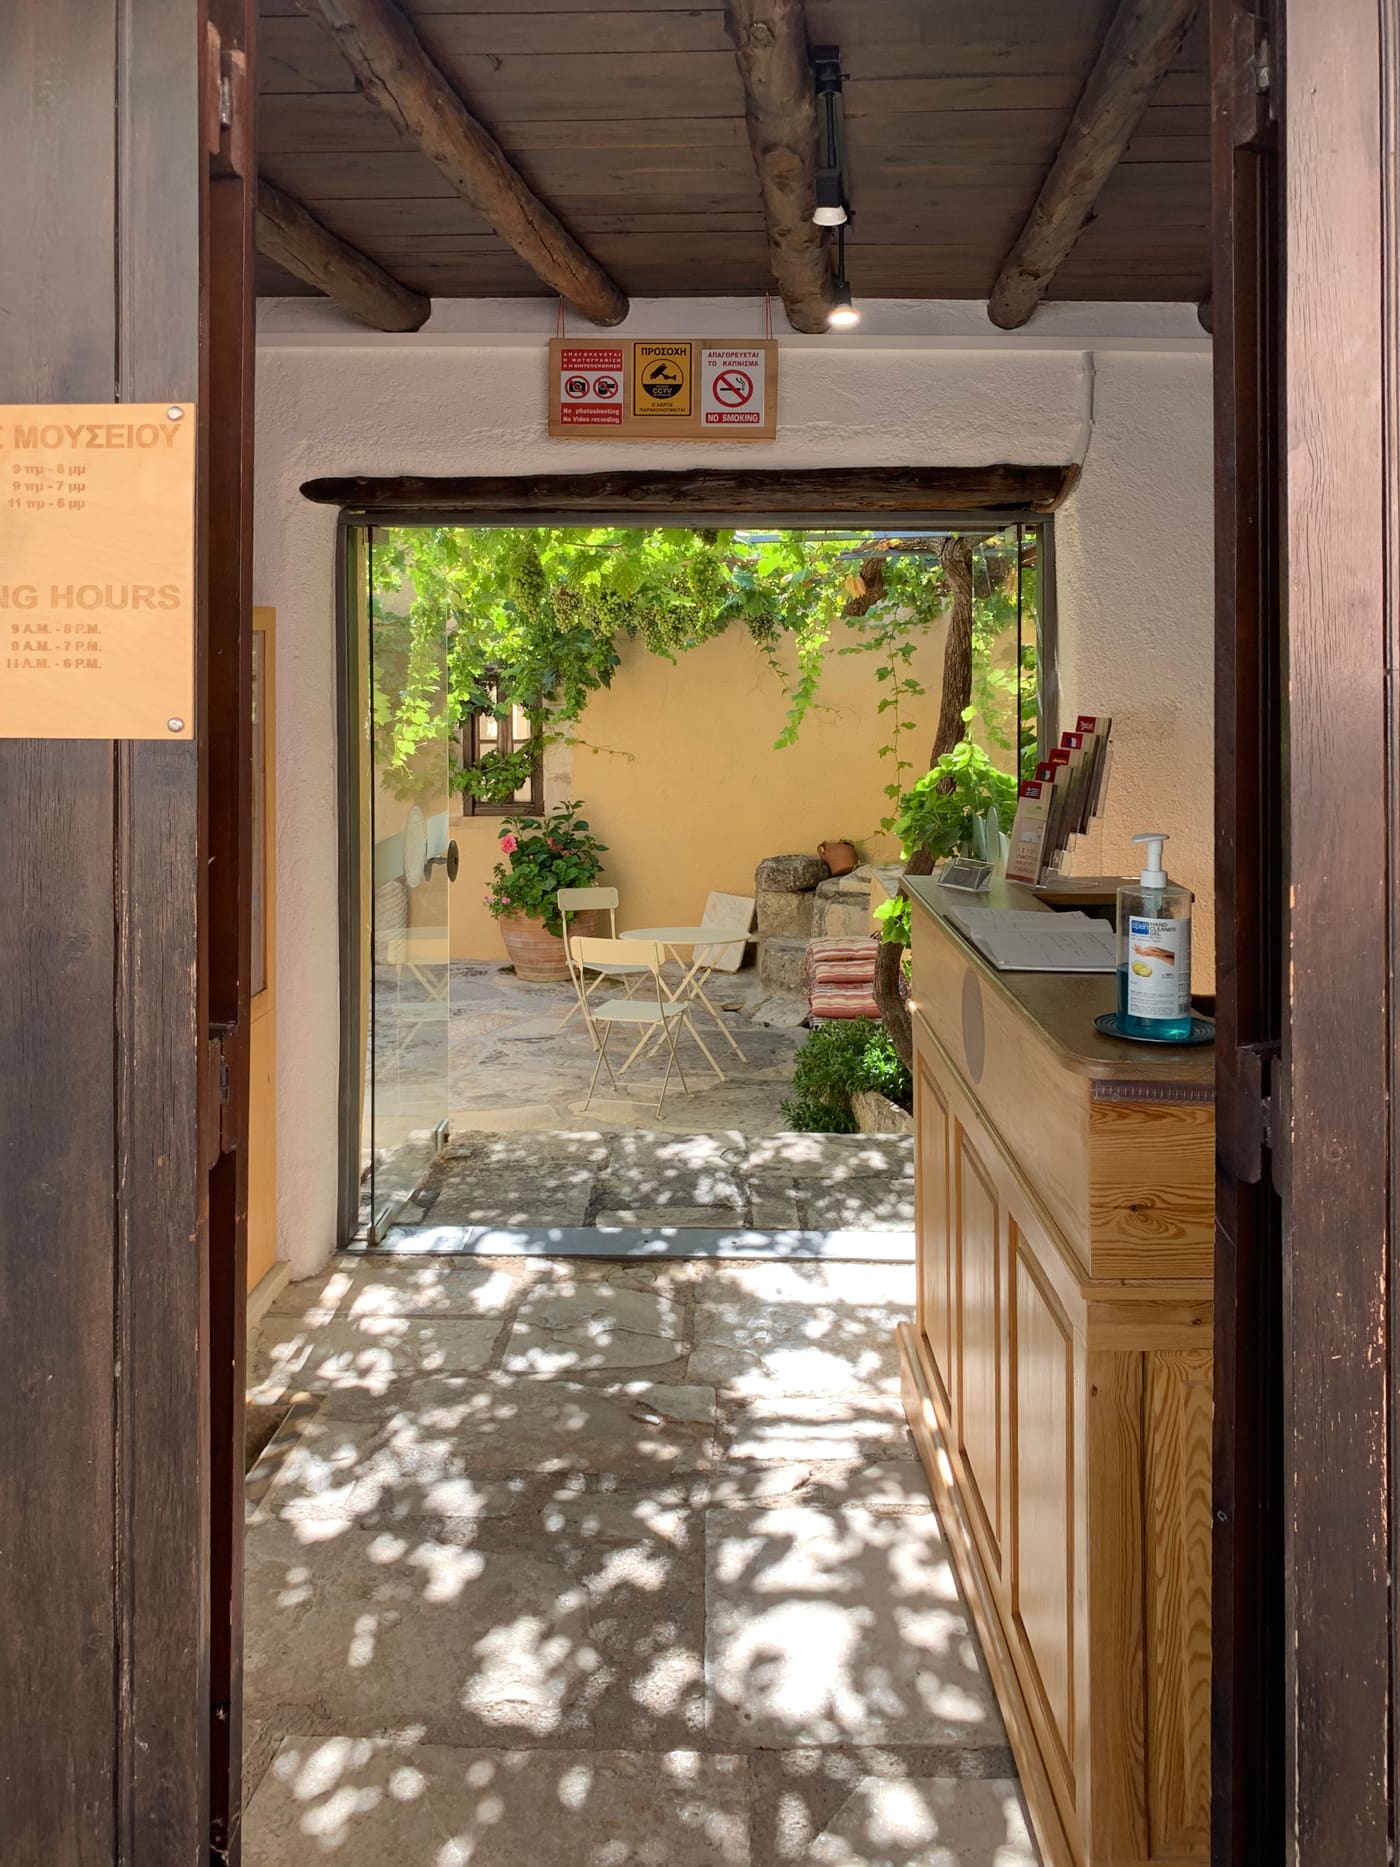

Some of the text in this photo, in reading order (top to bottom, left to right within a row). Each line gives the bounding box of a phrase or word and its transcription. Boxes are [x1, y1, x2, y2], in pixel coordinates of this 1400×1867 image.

[641, 347, 687, 356] ΠΡΟΣΟΧΗ
[575, 407, 620, 416] photoshooting
[591, 416, 620, 424] recording
[707, 413, 758, 423] NO SMOKING
[13, 423, 181, 449] ΜΟΥΣΕΙΟΥ
[12, 481, 20, 491] 9
[56, 481, 64, 491] 7
[8, 498, 21, 508] 11
[57, 498, 64, 508] 6
[50, 584, 181, 610] HOURS
[11, 624, 19, 634] 9
[23, 624, 52, 634] A.M.
[75, 624, 102, 634] P.M.
[11, 641, 19, 651] 9
[23, 641, 52, 651] A.M.
[75, 641, 102, 651] P.M.
[7, 658, 19, 668] 11
[22, 658, 51, 668] A.M.
[75, 658, 102, 668] P.M.
